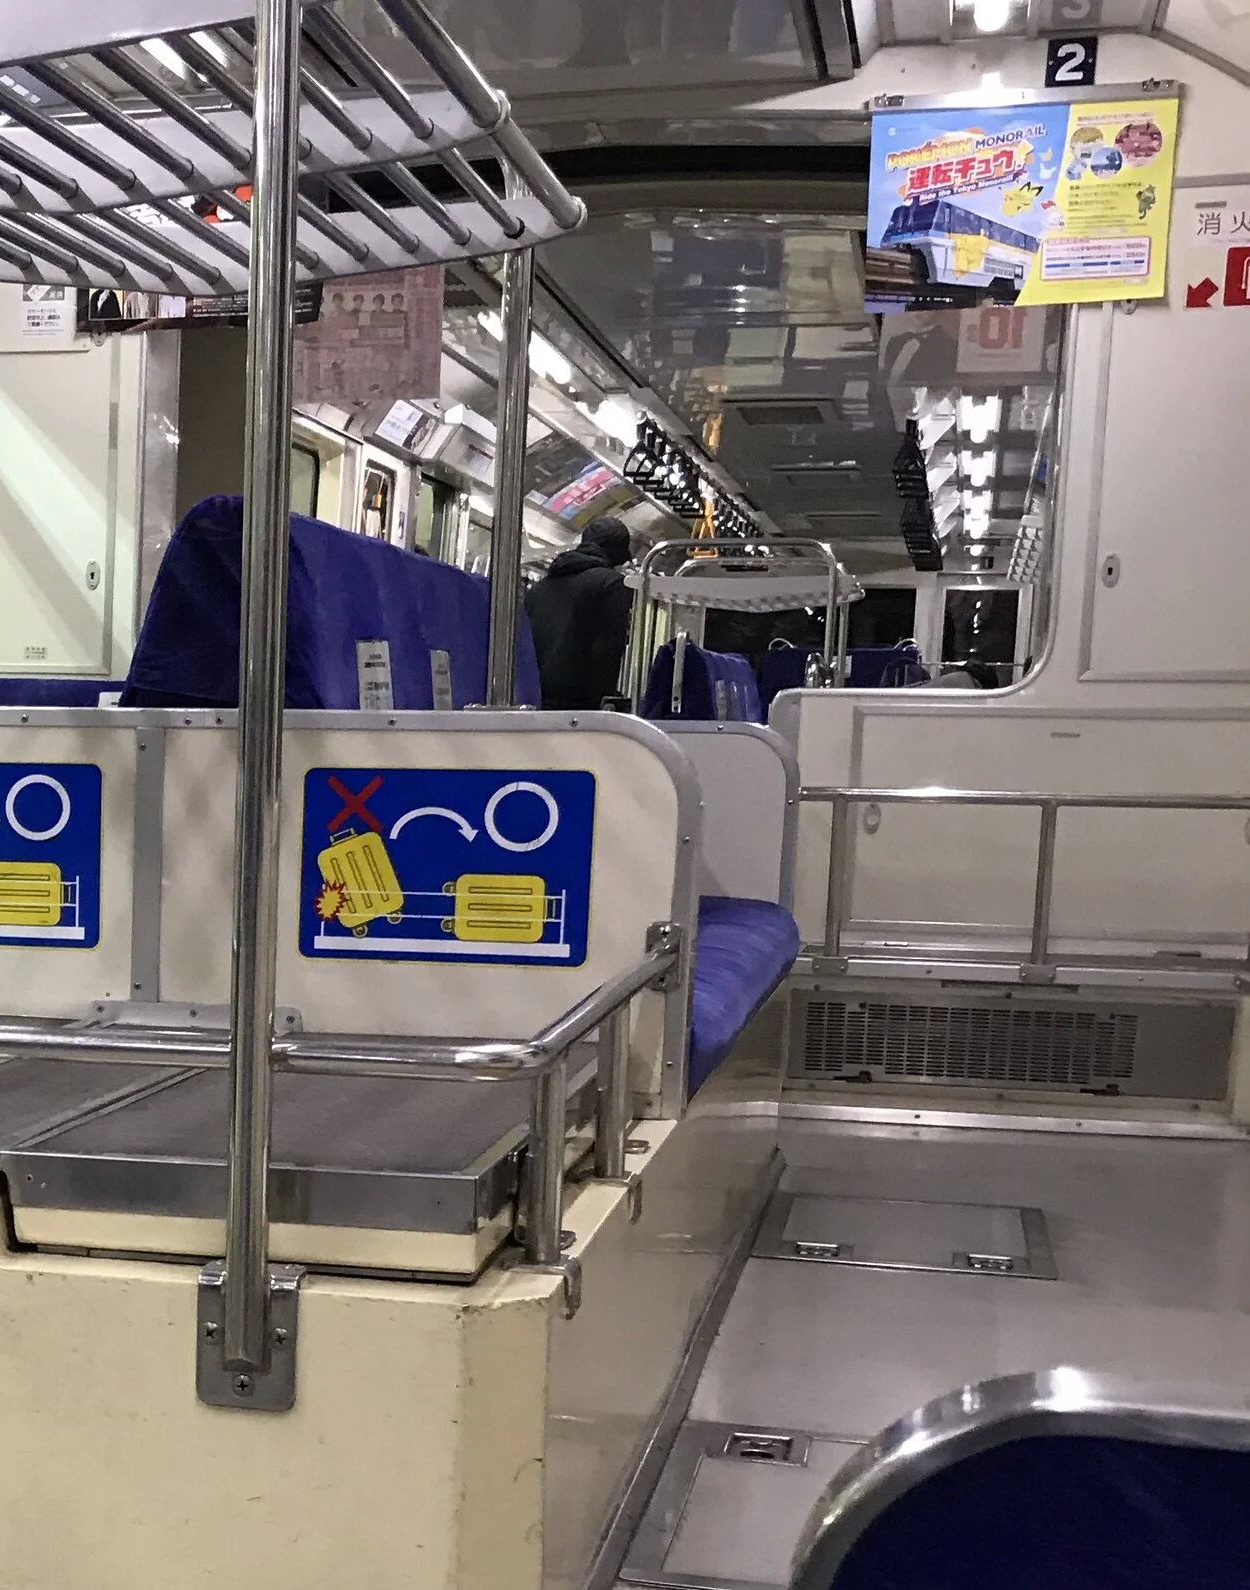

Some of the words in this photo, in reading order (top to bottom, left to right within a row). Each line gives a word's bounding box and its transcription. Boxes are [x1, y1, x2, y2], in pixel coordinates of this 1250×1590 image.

[1055, 43, 1086, 82] 2
[975, 124, 1046, 149] MONORAIL
[919, 192, 937, 202] Ride
[939, 189, 952, 197] the
[1197, 211, 1250, 236] 消火
